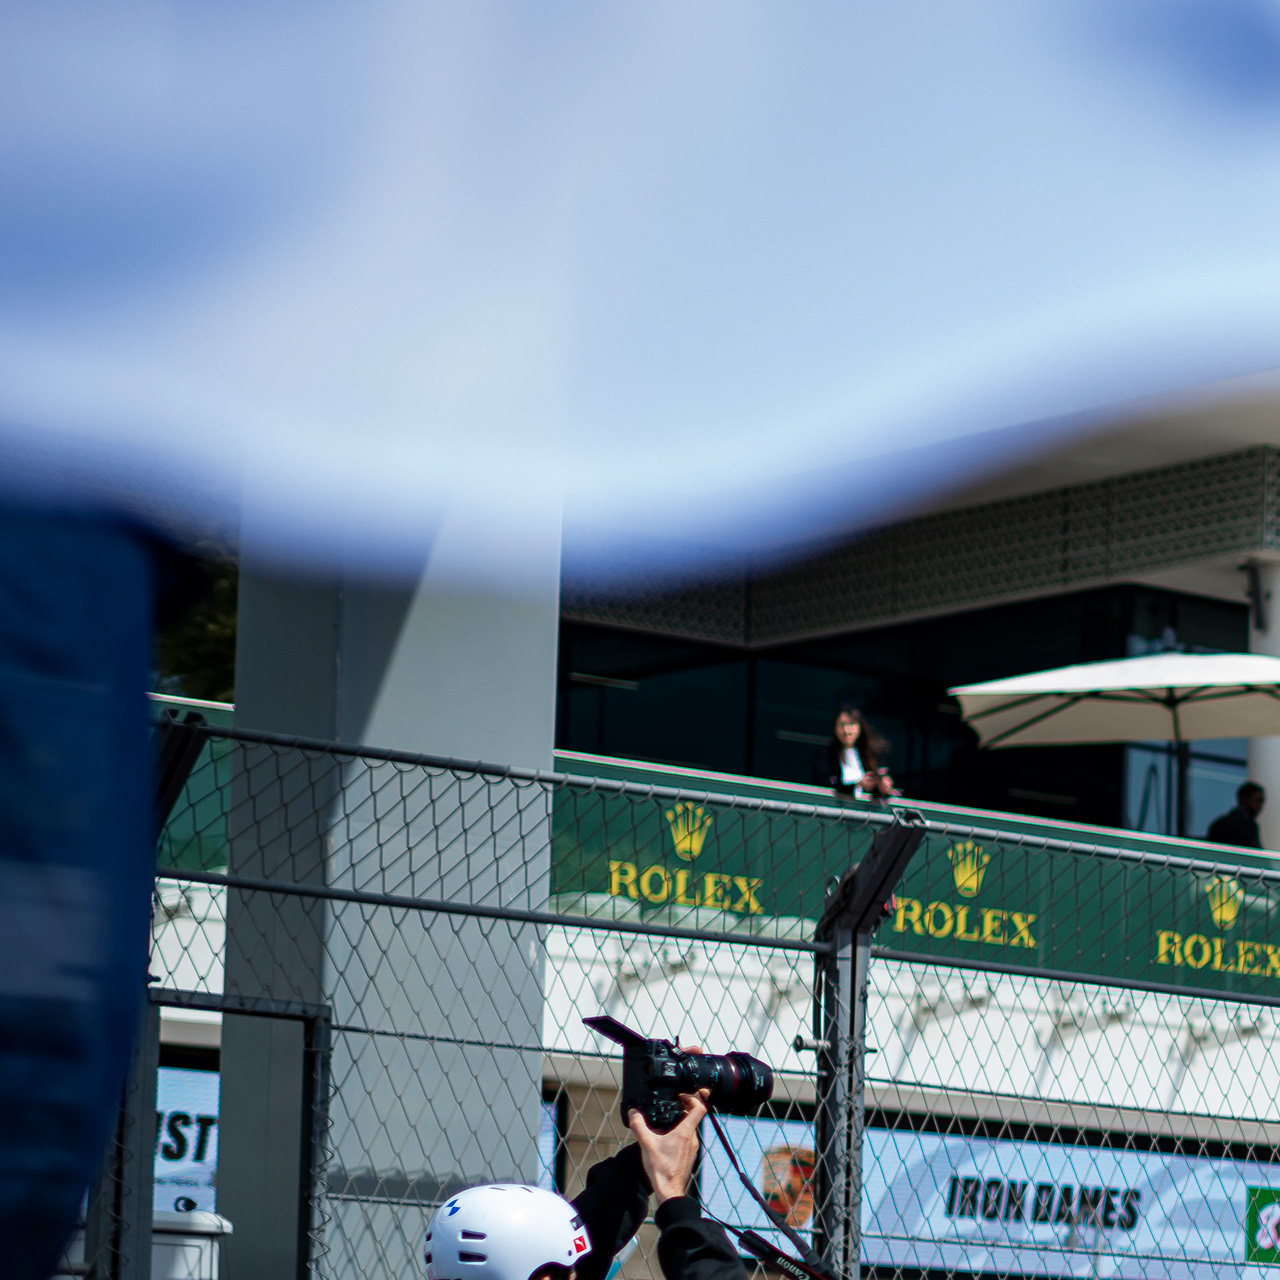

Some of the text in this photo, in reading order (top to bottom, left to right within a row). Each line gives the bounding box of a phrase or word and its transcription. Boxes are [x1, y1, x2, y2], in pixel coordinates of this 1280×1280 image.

[606, 860, 765, 916] ROLEX
[894, 897, 1039, 950] ROLEX
[945, 1175, 1142, 1232] IRON DAMES
